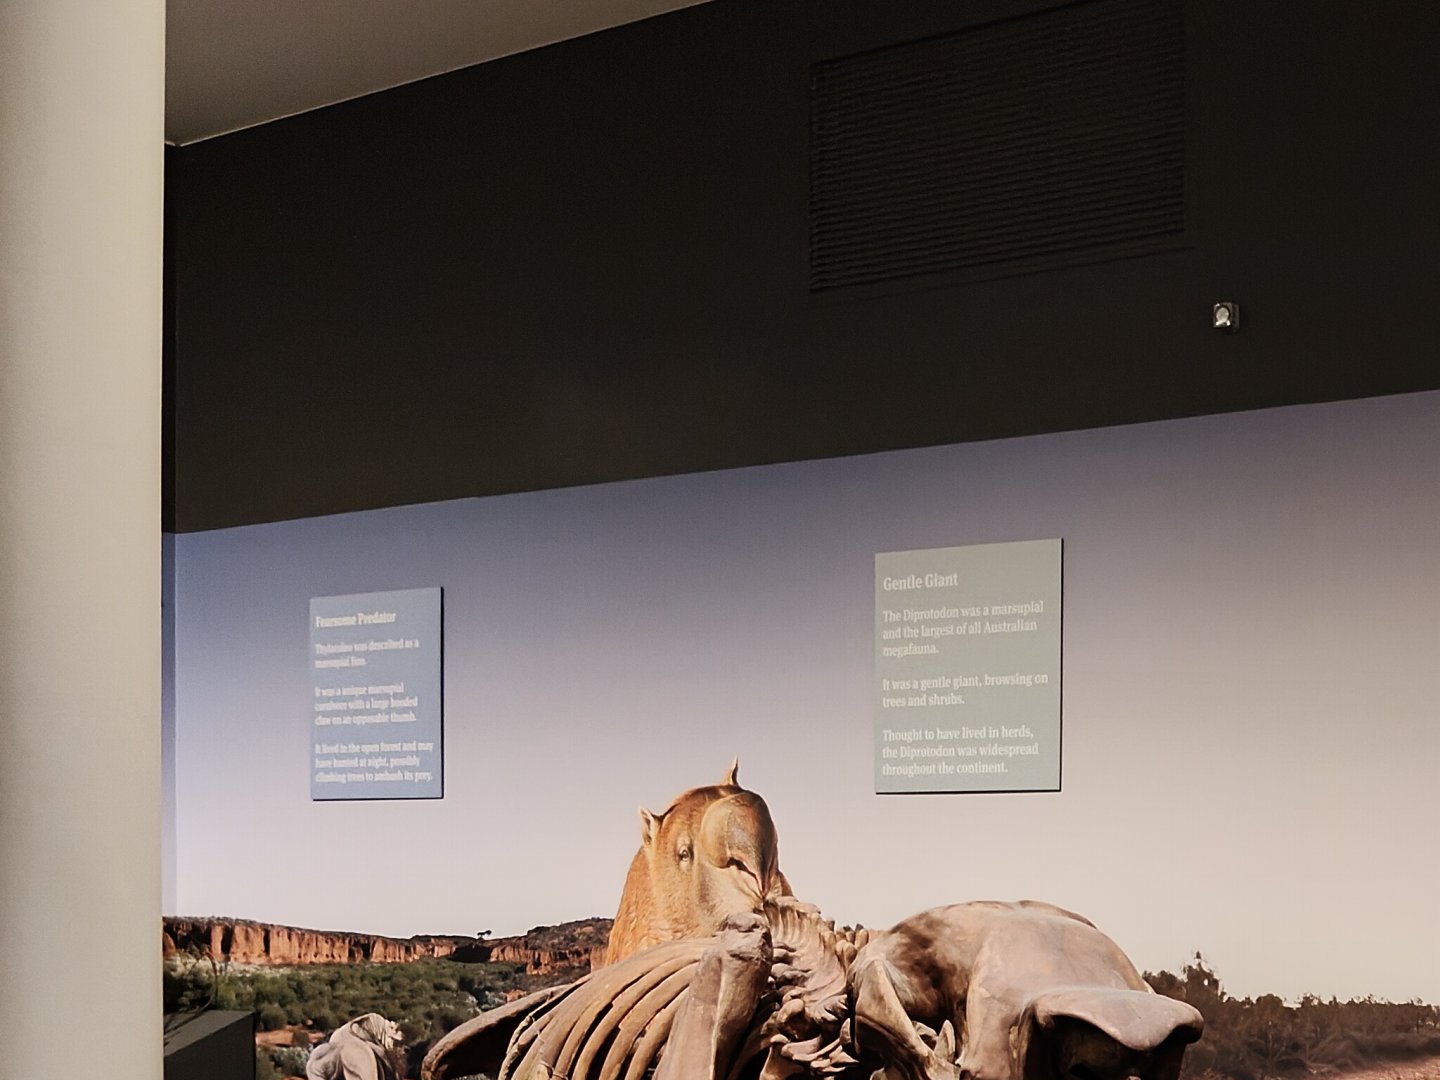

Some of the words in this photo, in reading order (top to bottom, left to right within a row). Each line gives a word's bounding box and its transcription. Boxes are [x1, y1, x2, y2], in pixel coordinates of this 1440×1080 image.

[883, 574, 922, 591] Gentle
[925, 573, 958, 588] Giant
[882, 610, 901, 622] The
[903, 606, 959, 623] Diprotodon
[960, 607, 981, 617] was
[983, 606, 989, 616] a
[991, 600, 1043, 616] marsupial
[883, 627, 901, 640] and
[903, 626, 919, 638] the
[921, 625, 954, 638] largest
[956, 622, 968, 635] of
[968, 621, 981, 634] all
[983, 619, 1037, 633] Australian
[883, 643, 939, 658] megafauna.
[883, 679, 890, 691] It
[892, 680, 911, 690] was
[912, 680, 919, 689] a
[920, 676, 951, 691] gentle
[984, 673, 1033, 686] browsing
[1034, 674, 1048, 684] on
[883, 697, 906, 708] trees
[907, 694, 927, 706] and
[928, 692, 965, 705] shrubs.
[883, 728, 922, 743] Thought
[924, 729, 935, 740] to
[936, 727, 960, 740] have
[962, 726, 986, 739] lived
[989, 726, 999, 738] in
[1001, 725, 1034, 738] herds,
[882, 747, 898, 759] the
[900, 745, 955, 760] Diprotodon
[957, 747, 977, 756] was
[979, 742, 1039, 758] widespread
[882, 763, 936, 778] throughout
[938, 762, 955, 775] the
[956, 761, 1008, 774] continent.
